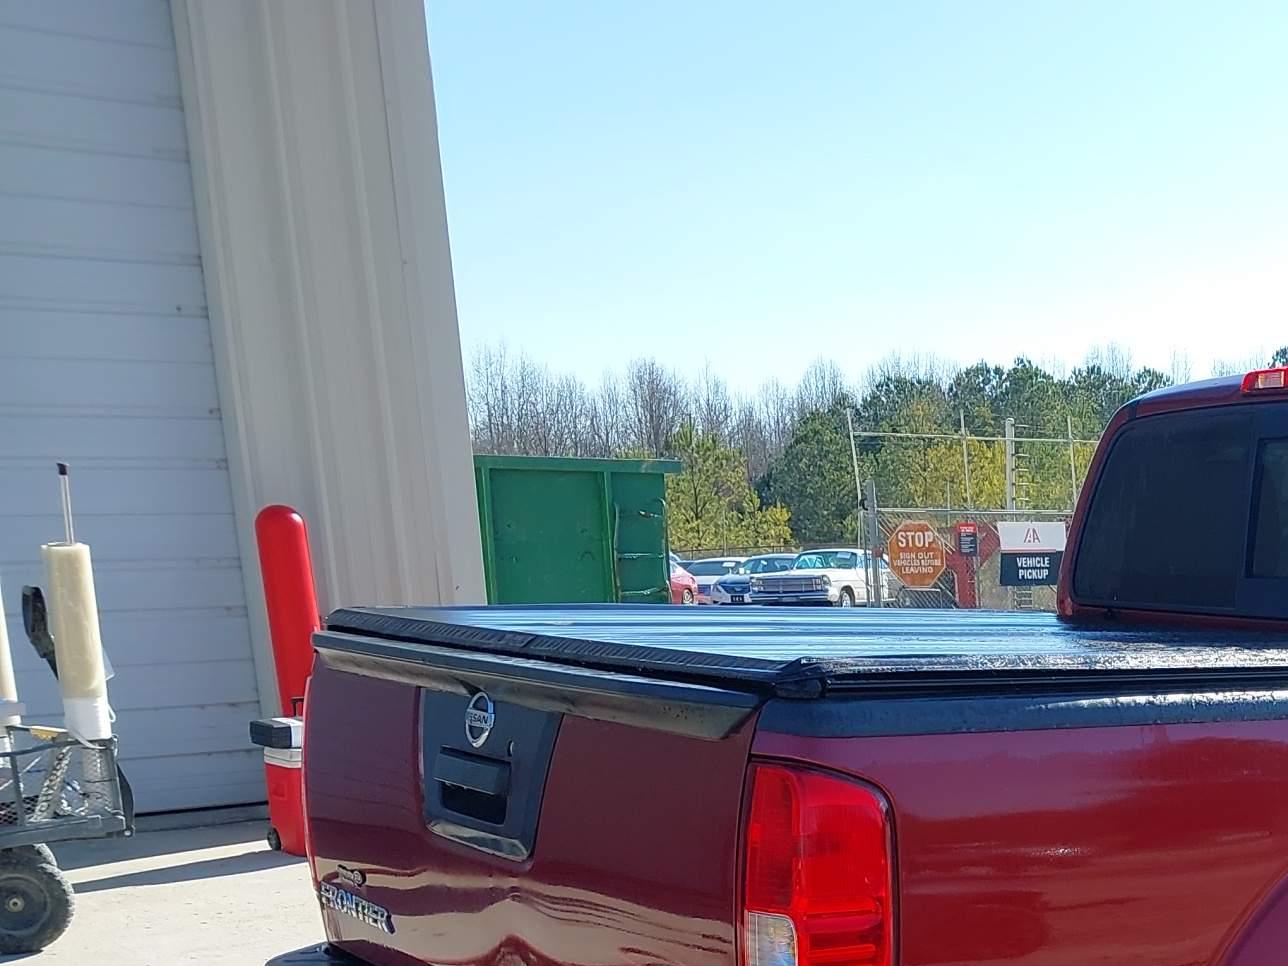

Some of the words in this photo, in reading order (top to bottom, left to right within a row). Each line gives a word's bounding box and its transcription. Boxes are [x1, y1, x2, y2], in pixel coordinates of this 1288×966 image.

[897, 531, 934, 548] STOP
[900, 551, 916, 560] SIGN
[917, 551, 935, 560] OUT
[1016, 556, 1050, 568] VEHICLE
[901, 566, 934, 575] LEAVING
[1018, 568, 1050, 580] PICKUP
